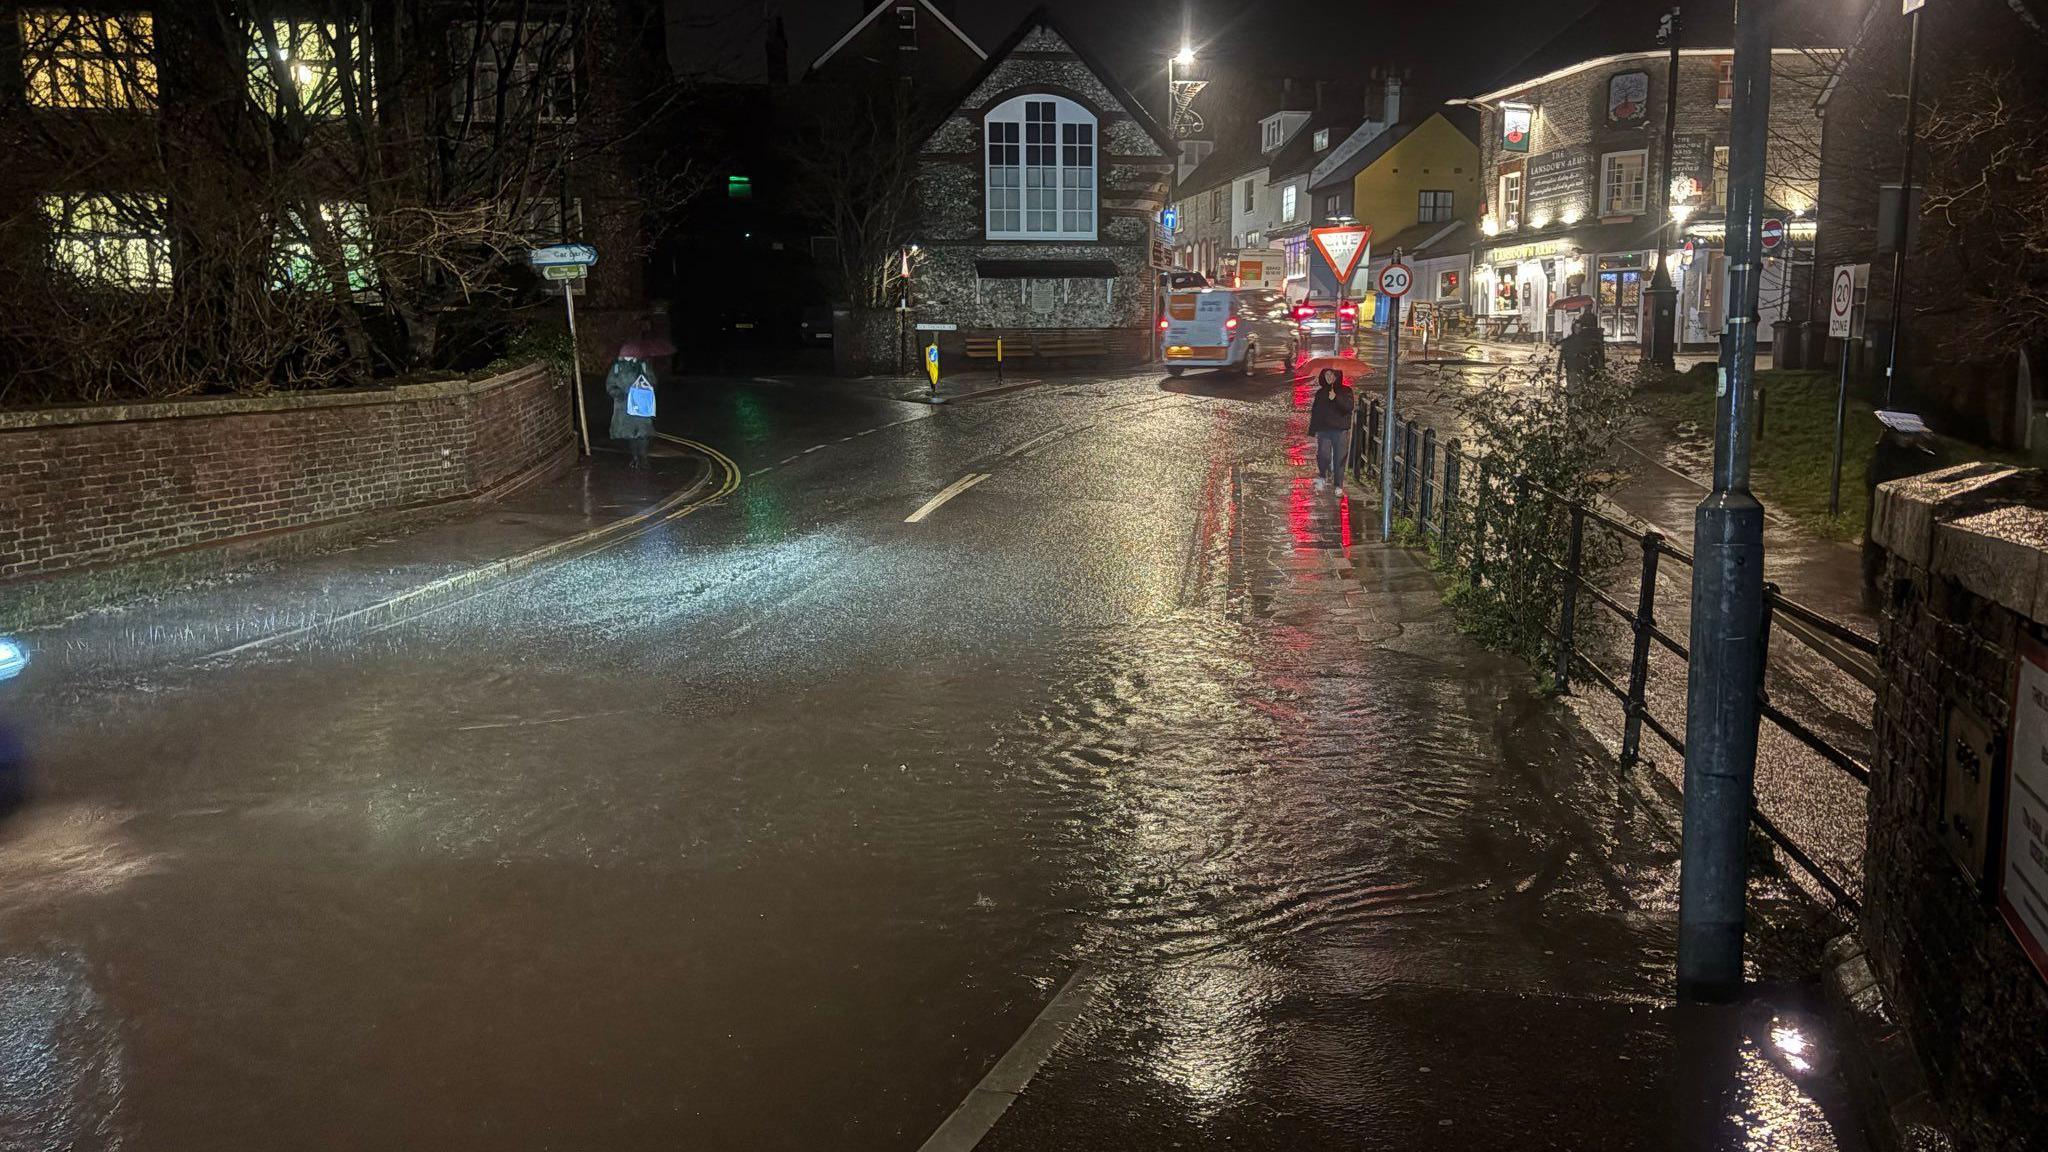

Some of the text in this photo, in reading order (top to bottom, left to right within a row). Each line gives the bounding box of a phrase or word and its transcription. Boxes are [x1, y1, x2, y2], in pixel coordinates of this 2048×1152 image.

[1551, 150, 1565, 160] THE
[1531, 156, 1586, 175] LANSDOWN ARMS
[1384, 273, 1407, 288] 20
[1837, 284, 1849, 302] 20
[1832, 320, 1847, 333] ZONE
